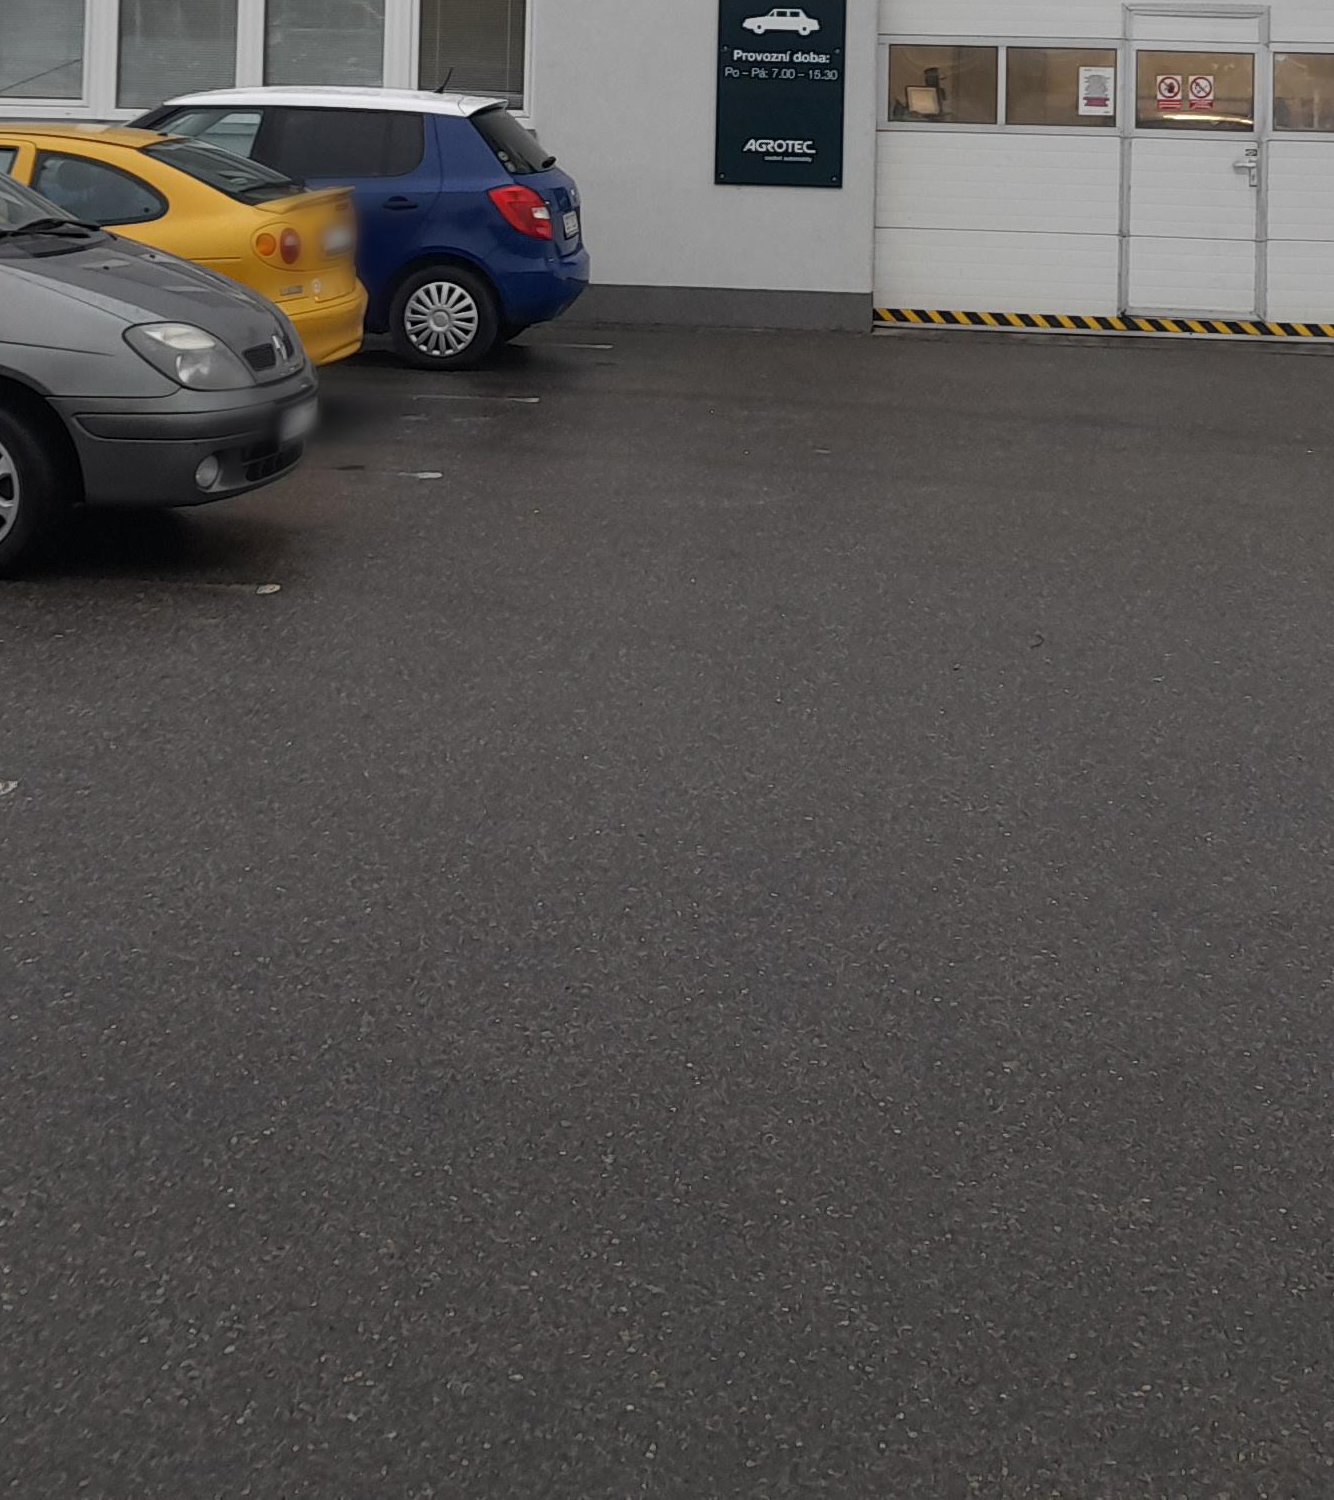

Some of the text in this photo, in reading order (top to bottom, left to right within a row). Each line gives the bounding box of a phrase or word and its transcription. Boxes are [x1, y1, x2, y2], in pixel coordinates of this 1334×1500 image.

[733, 49, 831, 63] Provozní doba:
[724, 66, 740, 78] Po
[771, 68, 796, 79] 7.00
[742, 138, 817, 154] AGROTEC
